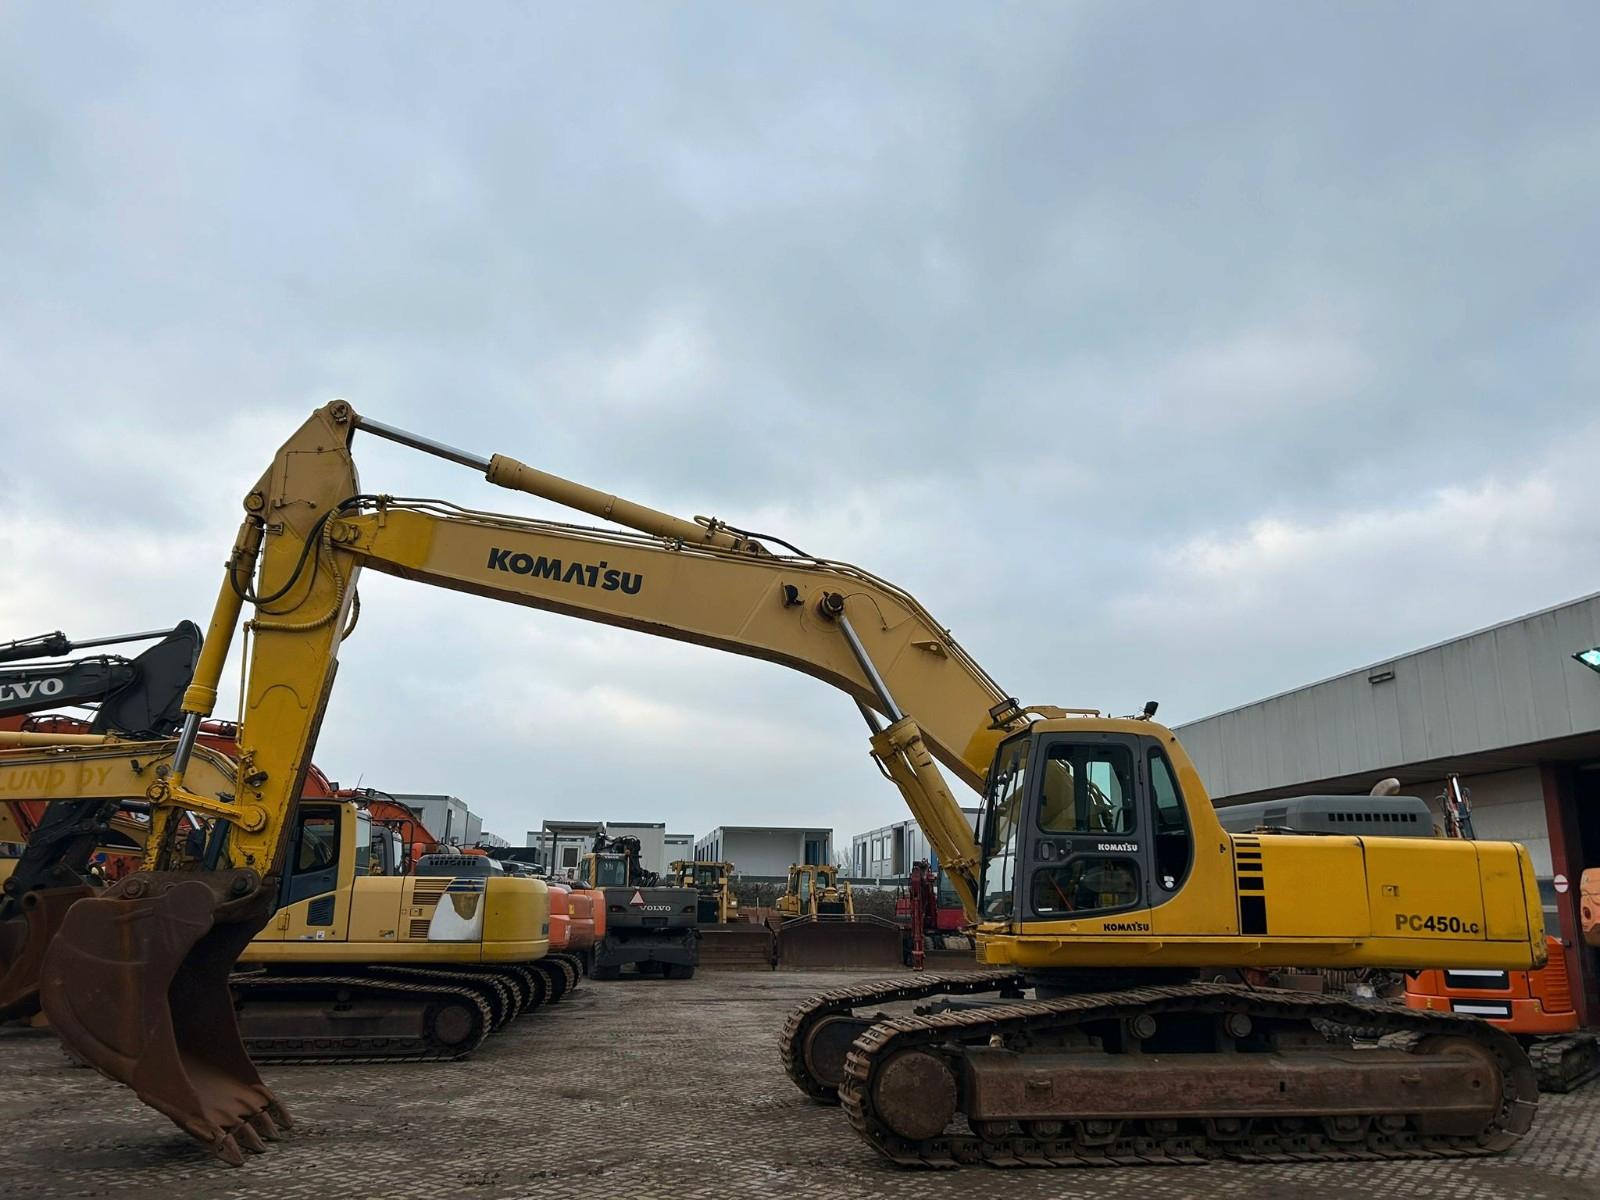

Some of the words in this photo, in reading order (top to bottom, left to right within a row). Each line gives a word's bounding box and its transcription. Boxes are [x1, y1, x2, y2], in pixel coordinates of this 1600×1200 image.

[487, 547, 643, 595] KOMATSU
[1098, 843, 1138, 851] KOMATSU
[1104, 921, 1149, 931] KOMATSU
[1395, 914, 1480, 934] PC450LC
